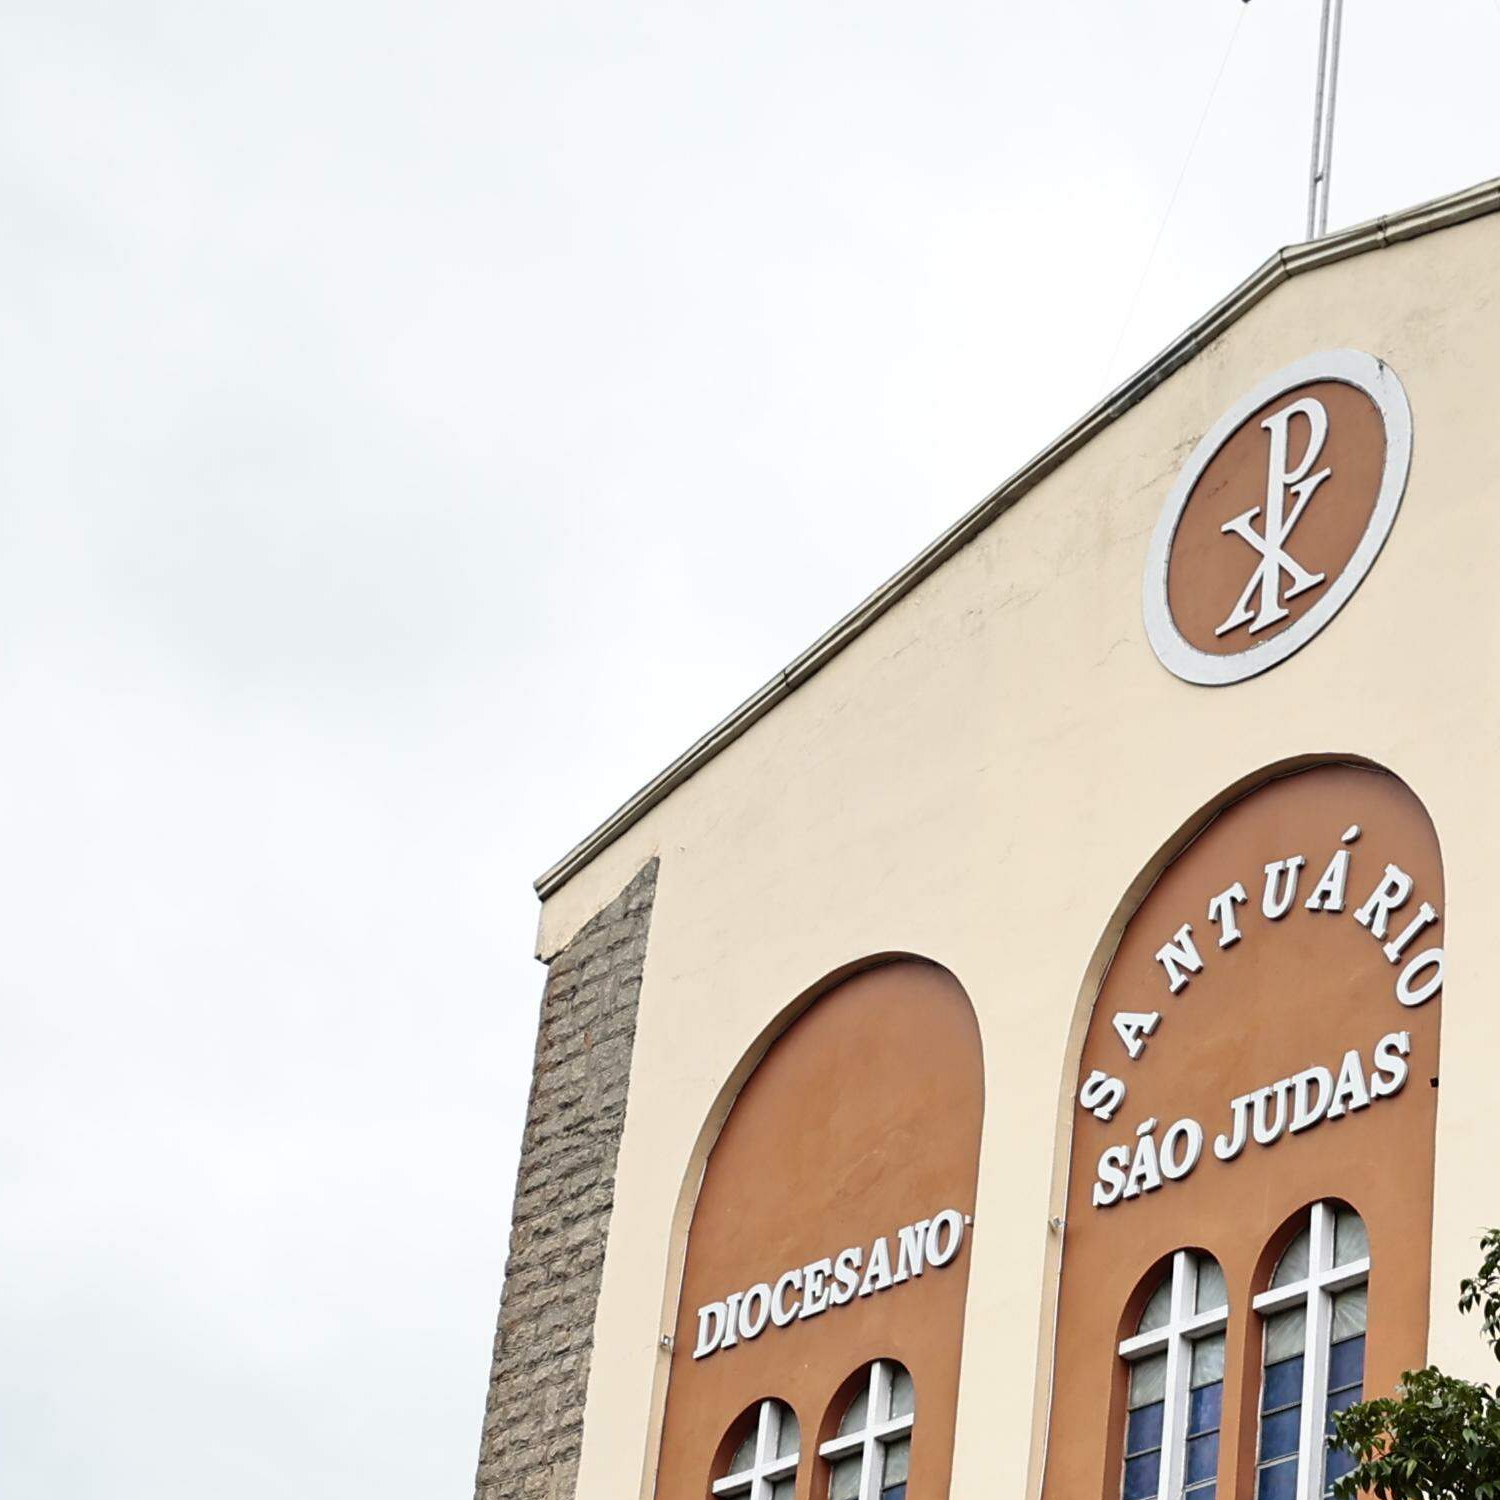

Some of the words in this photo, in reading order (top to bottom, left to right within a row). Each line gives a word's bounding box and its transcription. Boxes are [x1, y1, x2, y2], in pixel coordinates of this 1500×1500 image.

[1079, 824, 1445, 1121] SANTUÁRIO
[1213, 1030, 1411, 1161] JUDAS
[692, 1208, 965, 1360] DIOCESANO
